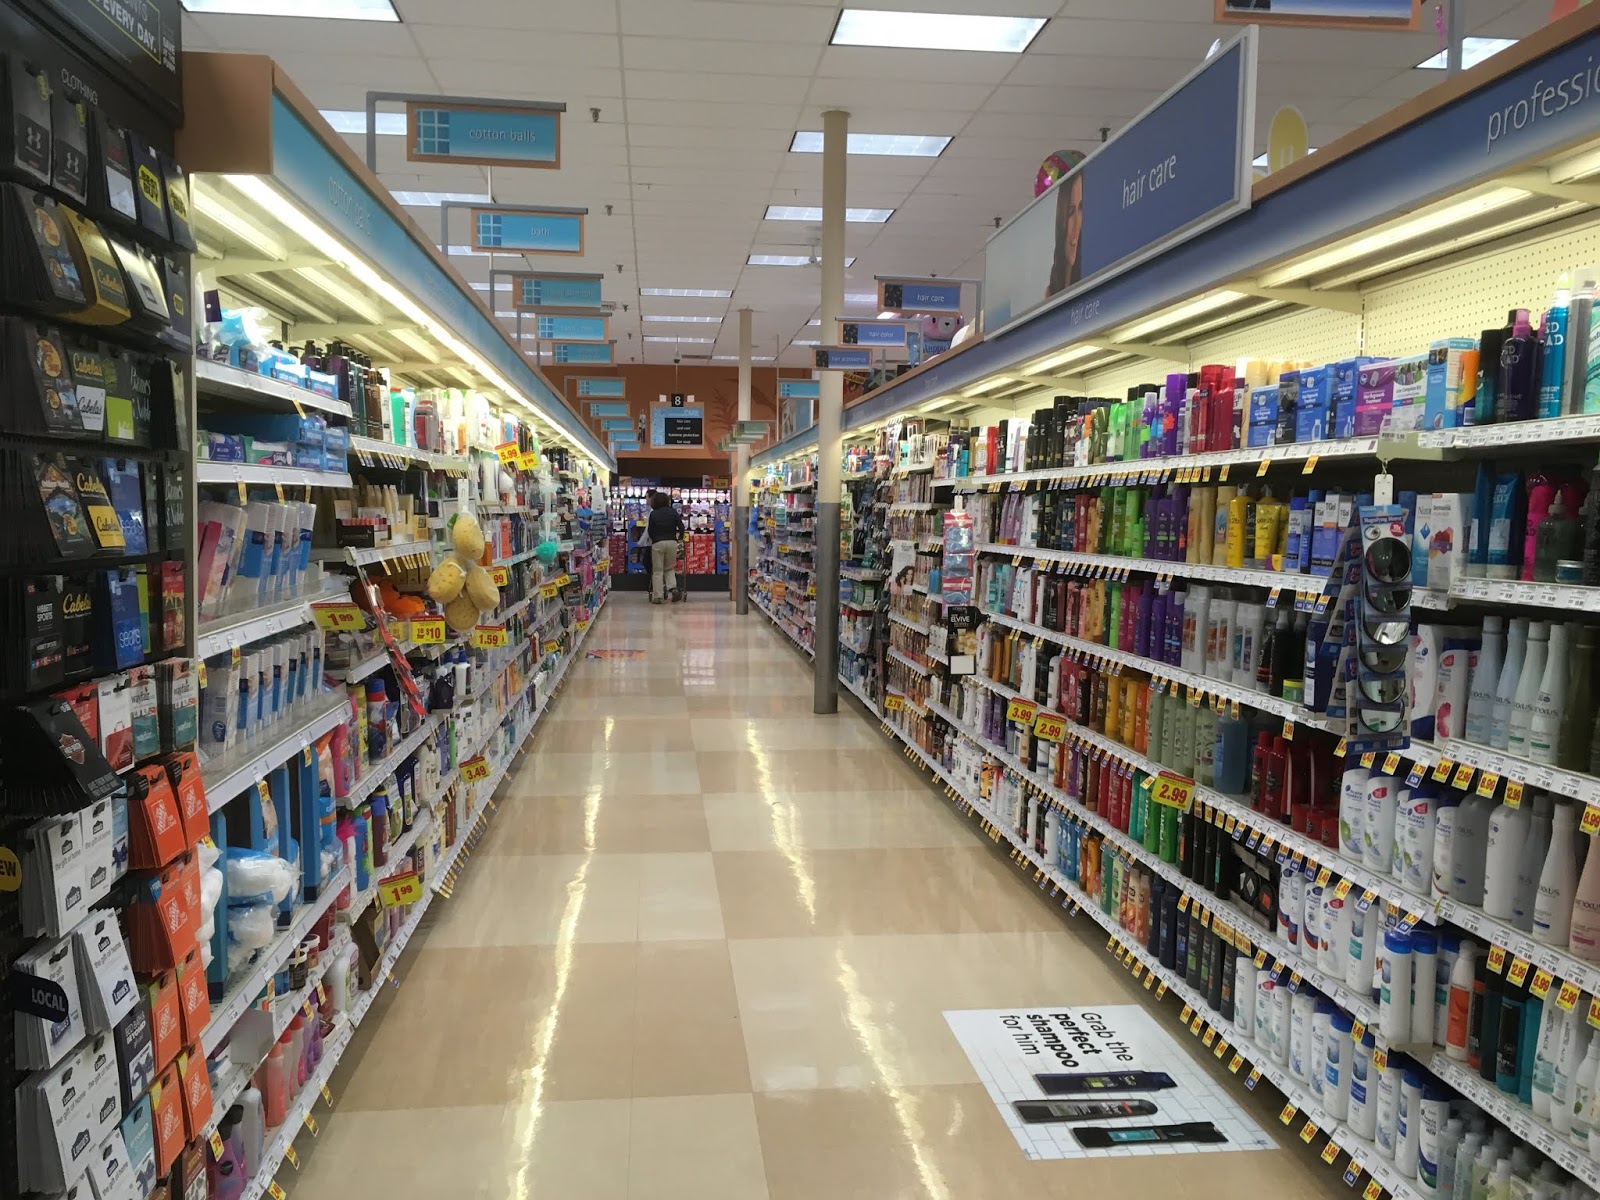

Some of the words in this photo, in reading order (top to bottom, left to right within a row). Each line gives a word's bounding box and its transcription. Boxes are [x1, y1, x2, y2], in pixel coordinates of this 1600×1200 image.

[61, 68, 98, 105] CLOTHING
[469, 127, 506, 142] cotton
[510, 127, 536, 143] balls
[1122, 169, 1147, 210] hair
[1149, 155, 1177, 191] care
[328, 175, 352, 220] cotton
[531, 226, 550, 236] bath
[916, 293, 931, 302] hair
[932, 294, 945, 303] care
[1070, 307, 1084, 326] hair
[1085, 300, 1100, 319] care
[868, 330, 880, 338] hair
[881, 330, 894, 338] color
[674, 395, 681, 406] 8
[500, 449, 517, 461] 5.99
[426, 627, 441, 639] $10
[478, 633, 499, 646] 1.59
[1012, 707, 1032, 721] 3.99
[1039, 723, 1061, 738] 2.99
[466, 765, 486, 780] 3.49
[1437, 763, 1450, 776] 8.99
[1456, 770, 1472, 783] 12.99
[1480, 777, 1495, 791] 8.99
[1159, 784, 1187, 804] 2.99
[1506, 787, 1521, 801] 12.99
[1583, 811, 1600, 828] 8.99
[1490, 951, 1503, 966] 8.99
[1511, 963, 1527, 979] 12.99
[1533, 975, 1550, 992] 8.99
[31, 987, 66, 1012] LOCAL
[1560, 989, 1577, 1004] 12.99
[1000, 1014, 1018, 1035] for
[1012, 1032, 1040, 1056] him
[1026, 1013, 1080, 1068] shampoo
[1050, 1012, 1102, 1056] perfect
[1081, 1011, 1113, 1039] Grab
[1108, 1038, 1134, 1062] the
